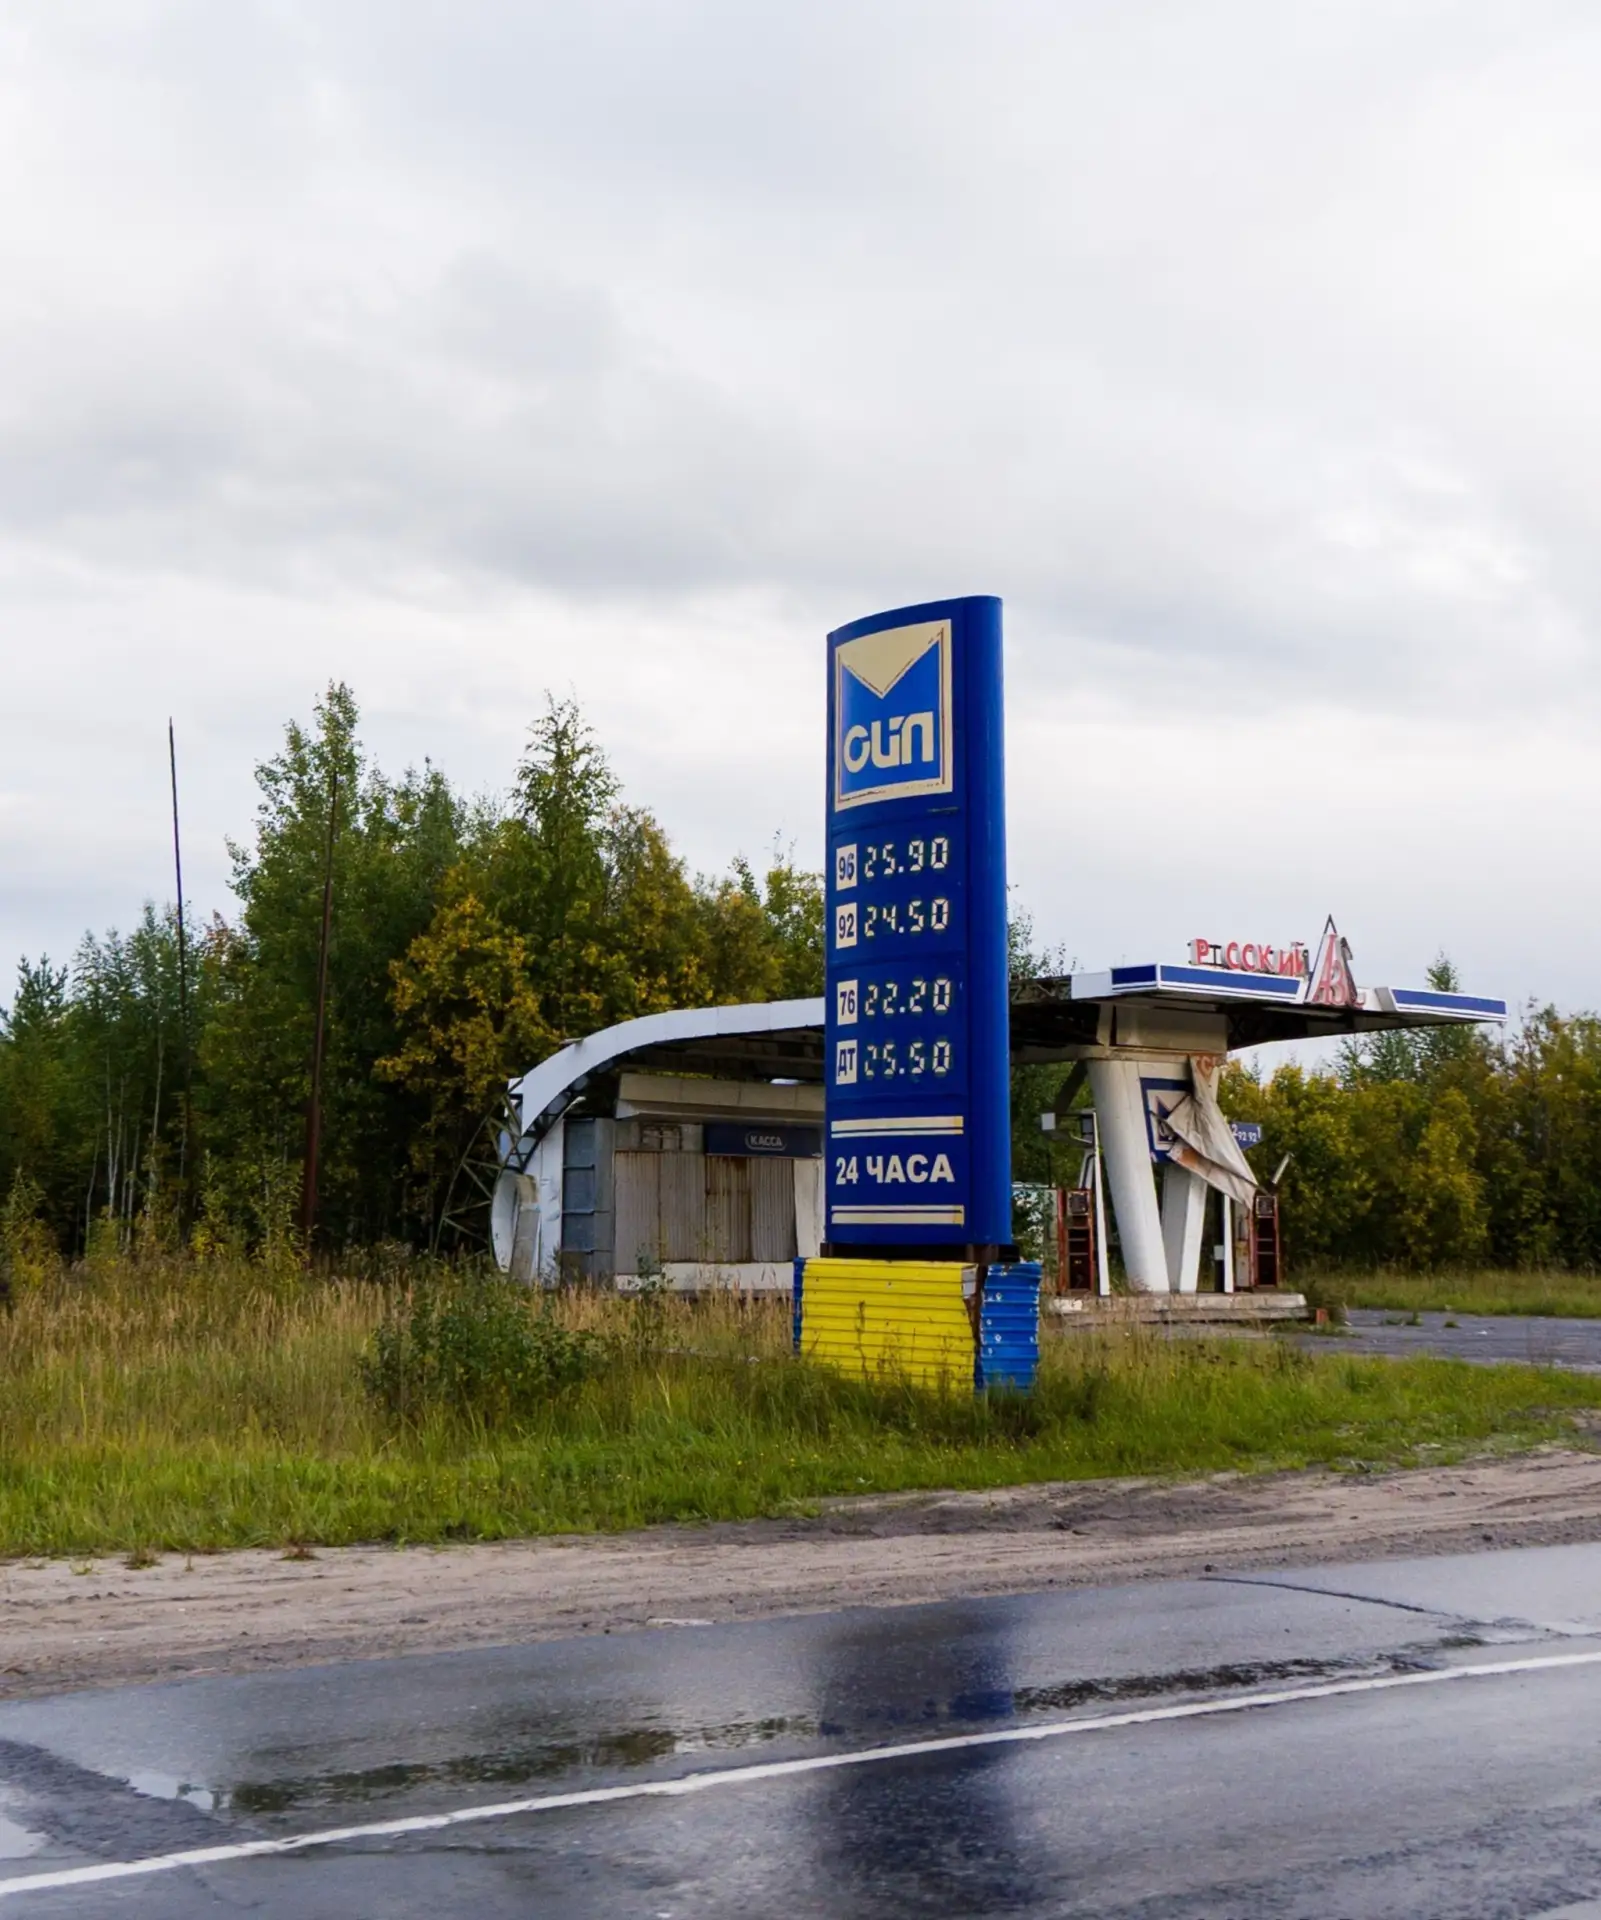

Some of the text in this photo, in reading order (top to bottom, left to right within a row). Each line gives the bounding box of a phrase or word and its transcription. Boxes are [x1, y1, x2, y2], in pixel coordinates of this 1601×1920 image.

[864, 837, 948, 878] 25.90
[838, 898, 949, 939] 92 24.50
[1189, 938, 1304, 977] РССКИЙ
[839, 979, 951, 1017] 76 22.20
[864, 1041, 950, 1076] 25.50
[750, 1135, 783, 1147] КАССА
[835, 1153, 955, 1185] 24 ЧАСА
